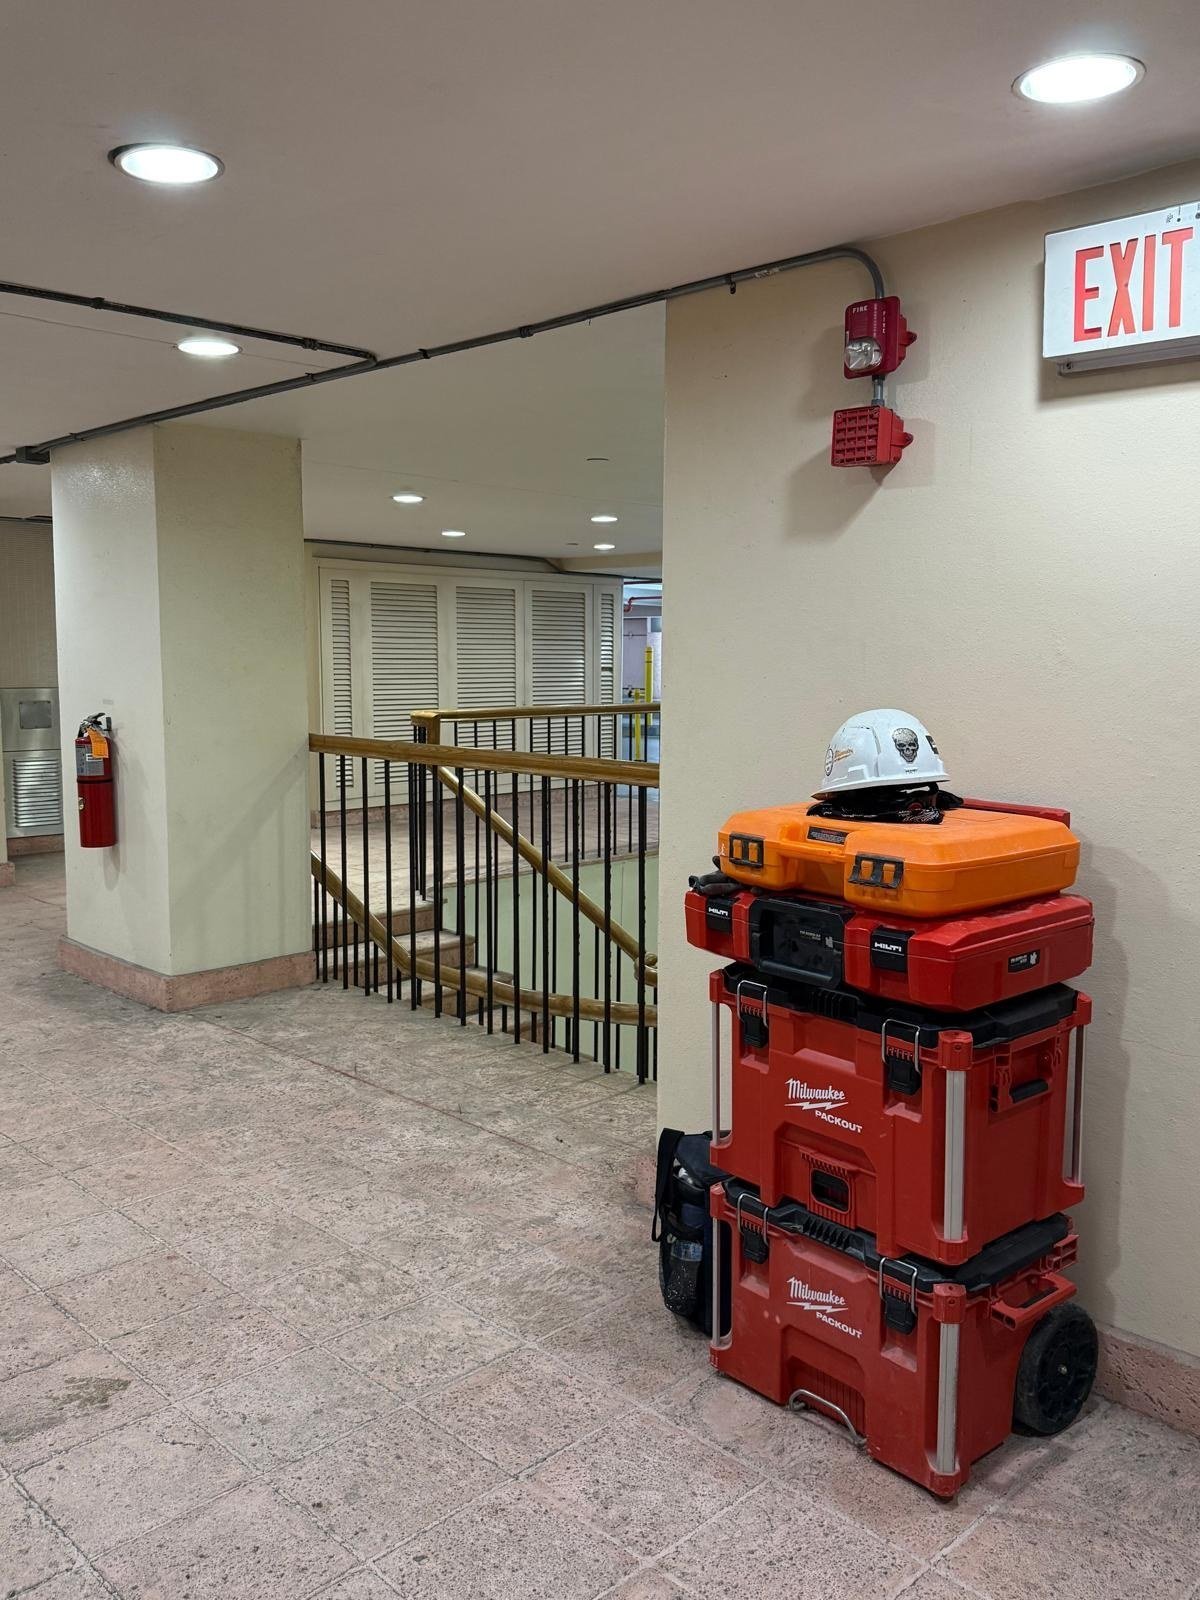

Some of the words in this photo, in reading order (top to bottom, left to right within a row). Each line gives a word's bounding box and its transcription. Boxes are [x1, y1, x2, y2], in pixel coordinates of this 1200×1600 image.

[1073, 226, 1194, 343] EXIT
[852, 305, 868, 314] FIRE
[708, 906, 729, 917] HILTI
[874, 941, 902, 953] HILTI
[784, 1077, 846, 1100] Milwaukee
[815, 1109, 863, 1134] PACKOUT
[786, 1276, 846, 1306] Milwaukee
[815, 1311, 863, 1339] PACKOUT
